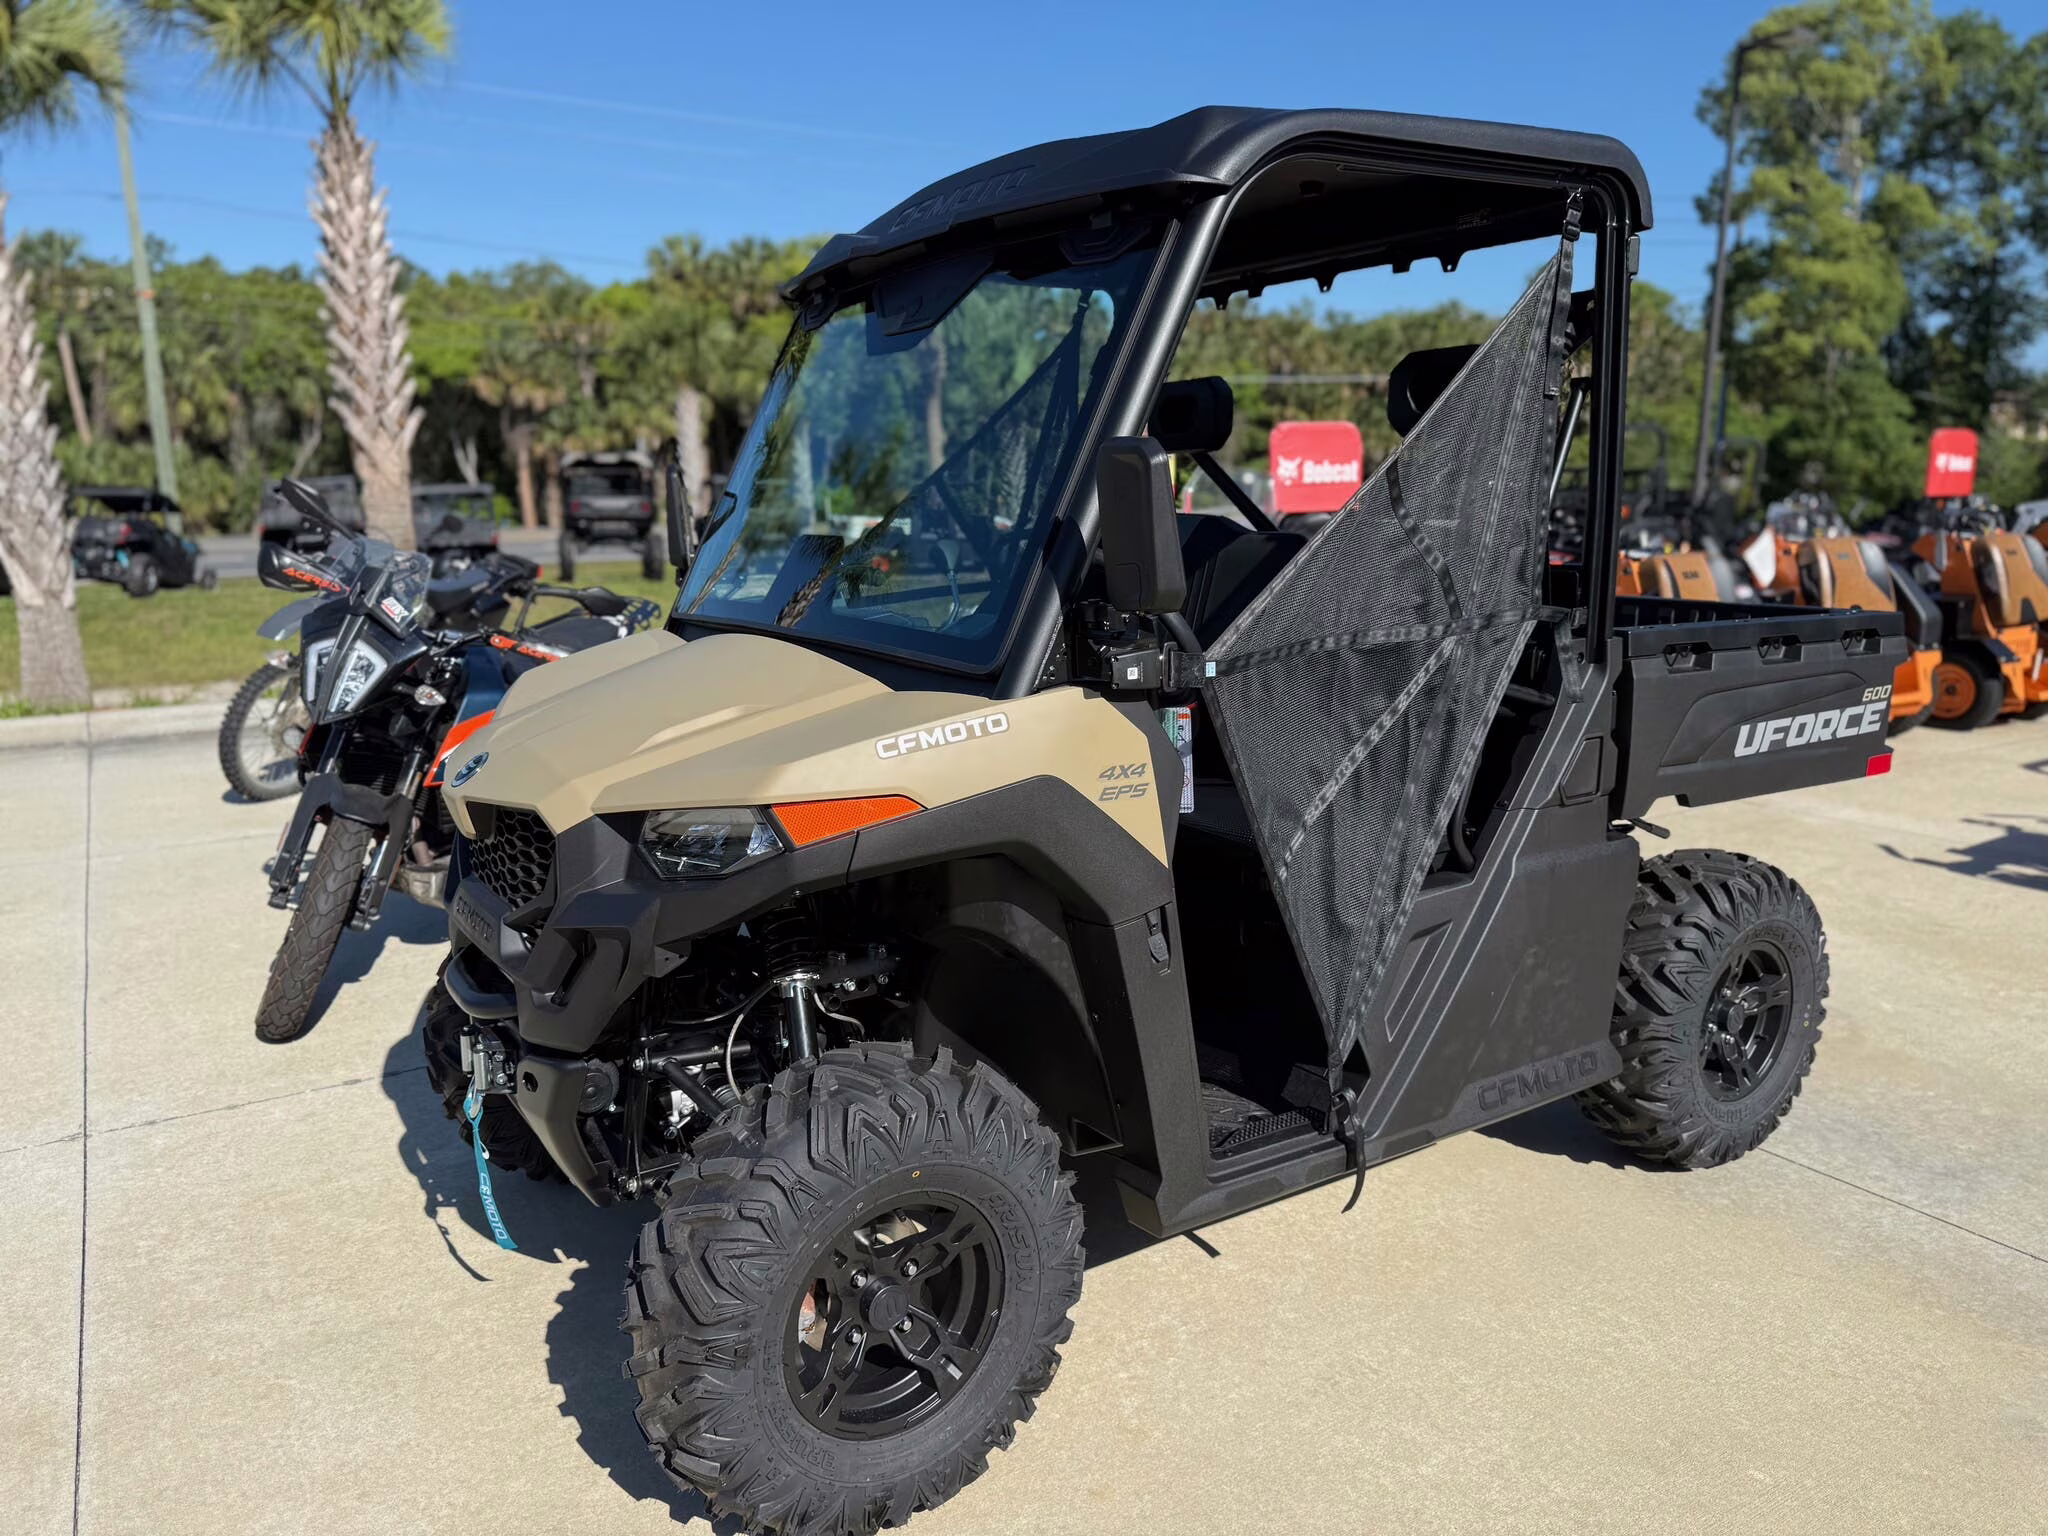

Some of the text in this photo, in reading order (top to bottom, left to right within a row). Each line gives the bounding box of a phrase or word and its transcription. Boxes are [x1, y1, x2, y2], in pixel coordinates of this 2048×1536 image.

[1302, 459, 1359, 484] Bobcat
[1863, 684, 1892, 701] 600
[875, 713, 1006, 758] CFMOTO
[1734, 701, 1887, 758] UFORCE
[1098, 762, 1147, 780] 4X4
[1098, 782, 1149, 801] EPS
[1475, 1050, 1598, 1111] CFMOTO
[480, 1172, 508, 1240] CFMOTO
